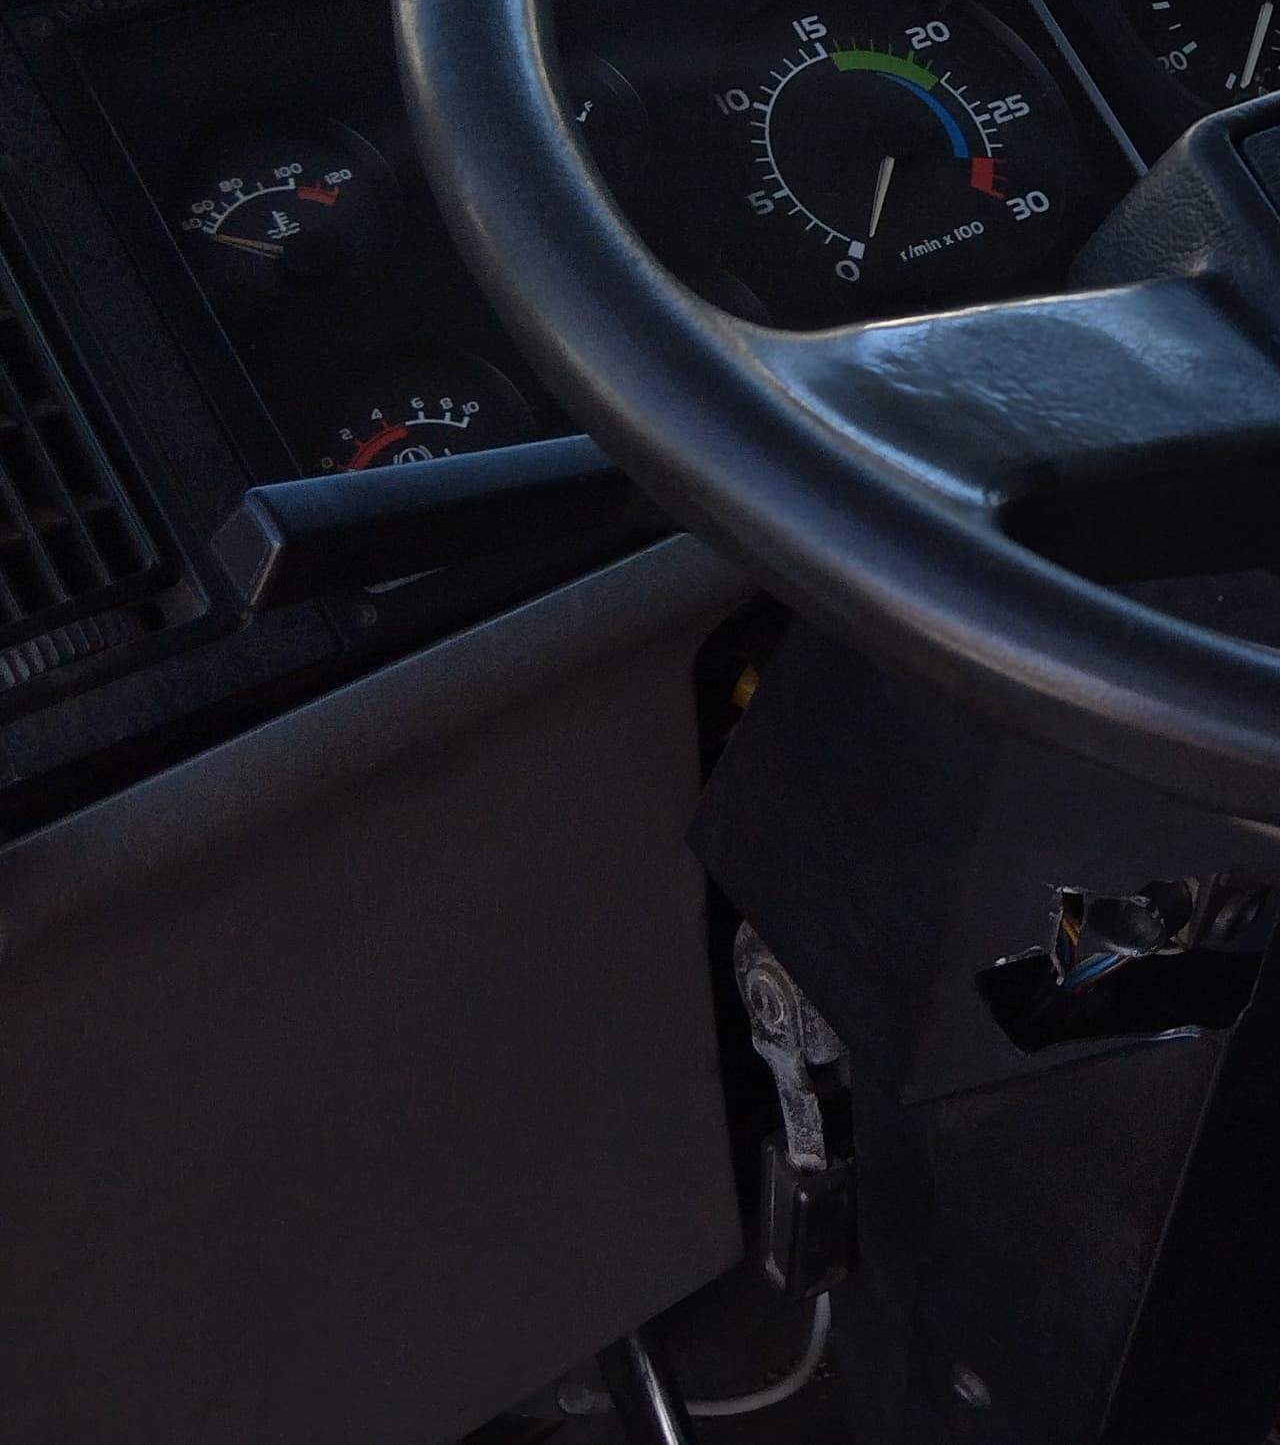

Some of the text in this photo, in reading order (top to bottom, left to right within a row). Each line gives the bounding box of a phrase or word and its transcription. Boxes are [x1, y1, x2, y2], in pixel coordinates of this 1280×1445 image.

[792, 15, 828, 42] 15
[905, 20, 950, 50] 20
[715, 89, 750, 115] 10
[987, 94, 1030, 124] 25
[272, 162, 303, 179] 100
[324, 168, 353, 186] 120
[218, 176, 244, 194] 80
[191, 199, 215, 215] 60
[748, 190, 775, 215] 5
[1005, 190, 1050, 221] 30
[835, 259, 860, 282] 0
[410, 396, 425, 410] 6
[440, 396, 454, 410] 8
[462, 400, 480, 415] 10
[370, 407, 384, 422] 4
[339, 428, 353, 441] 2
